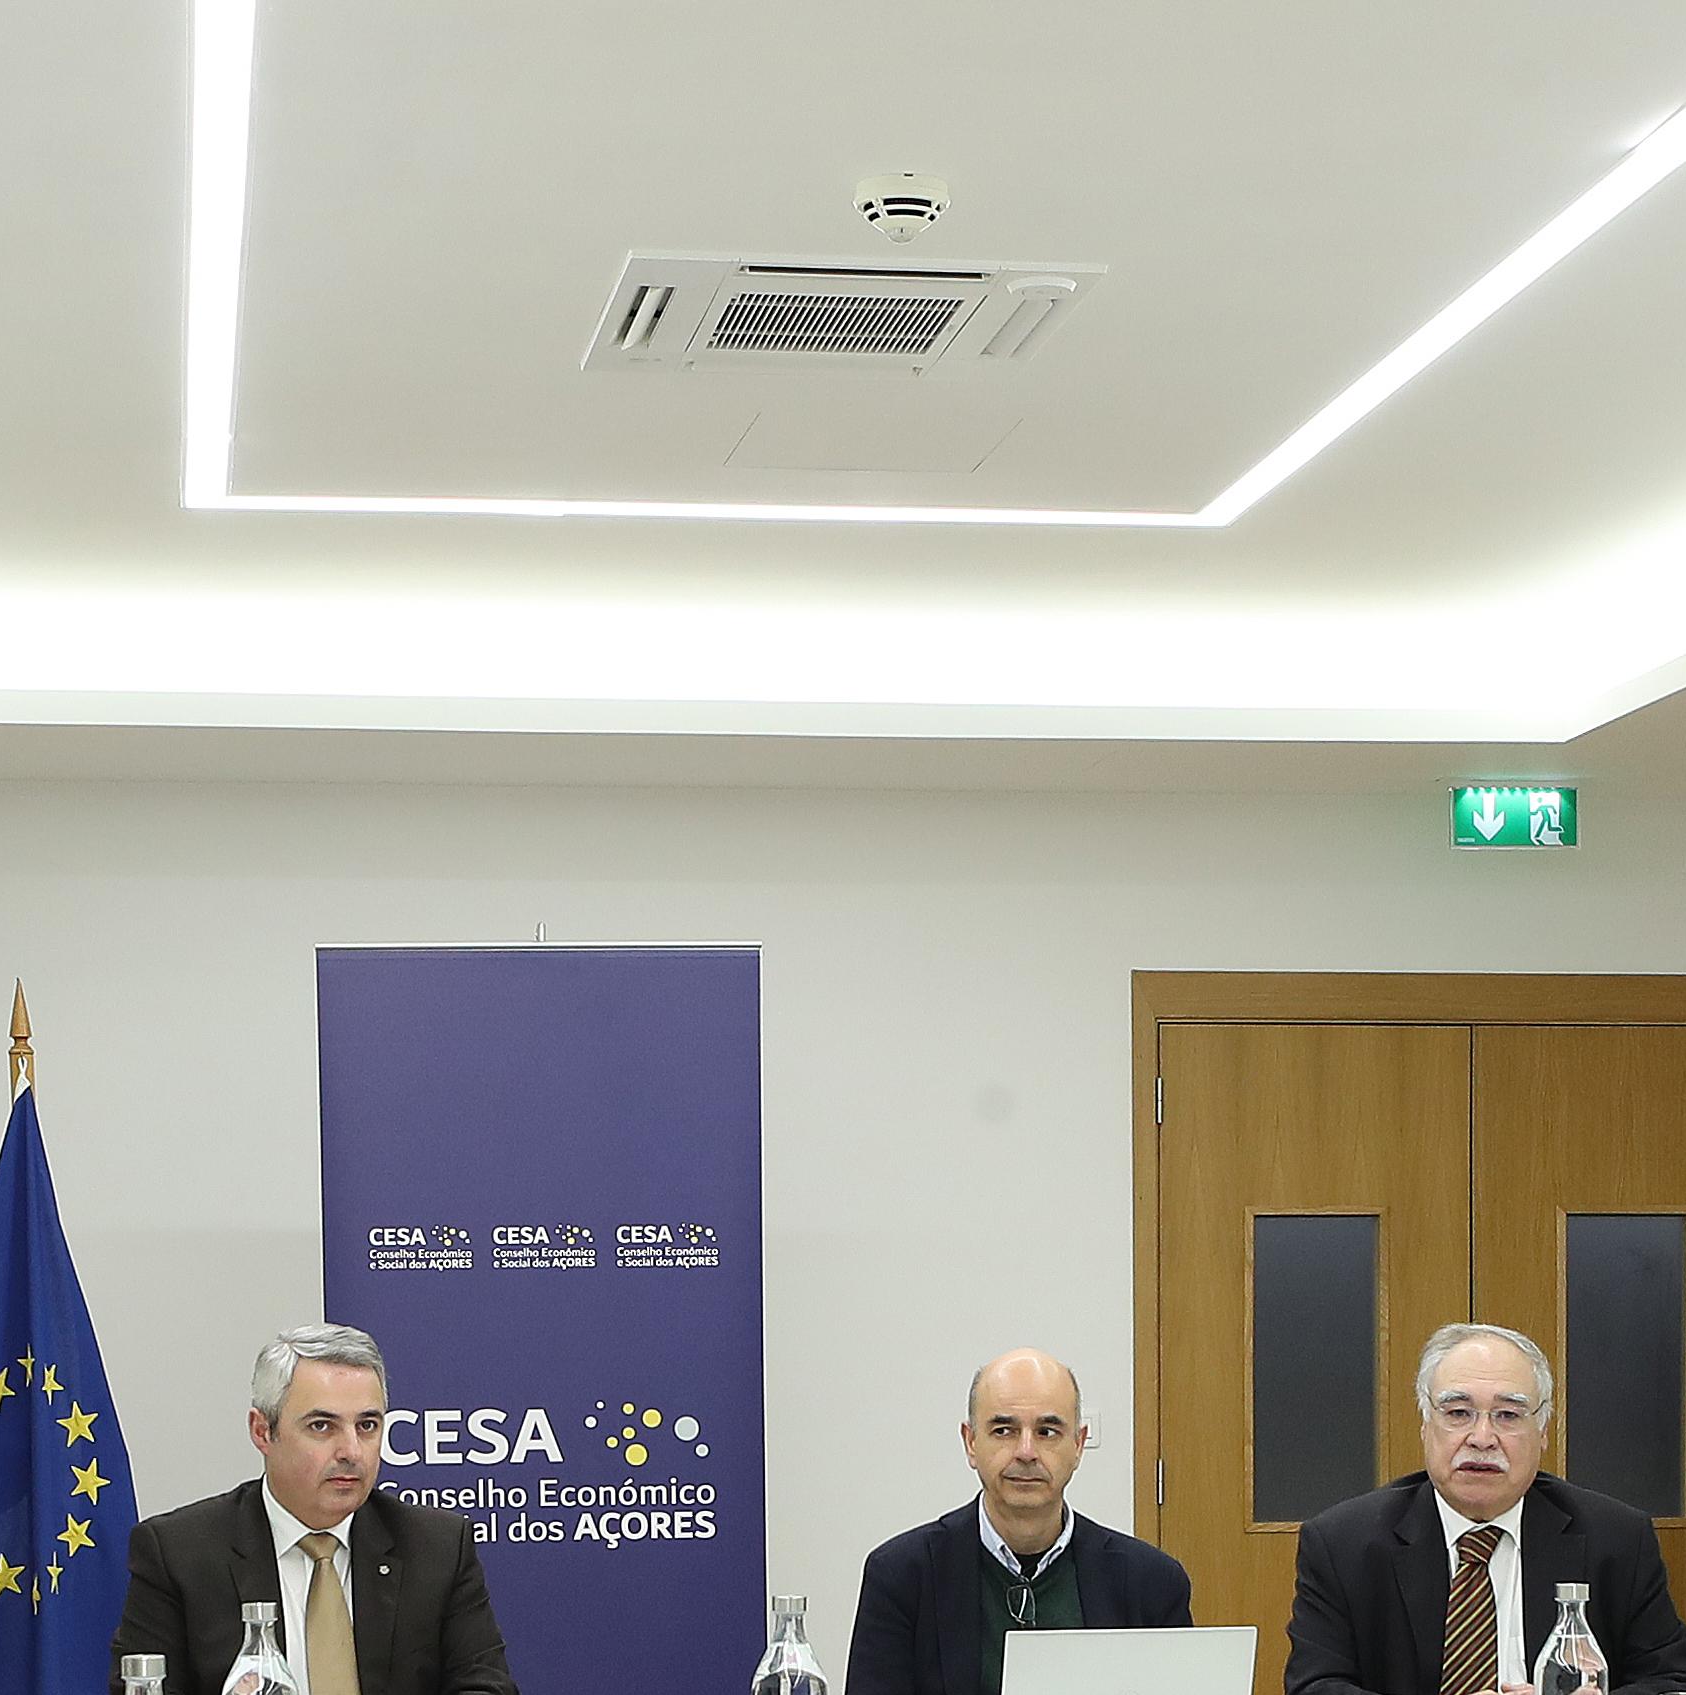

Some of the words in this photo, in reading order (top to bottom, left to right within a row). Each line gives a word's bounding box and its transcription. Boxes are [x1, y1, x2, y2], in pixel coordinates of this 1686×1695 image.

[369, 1227, 427, 1246] CESA
[492, 1226, 550, 1245] CESA
[616, 1225, 674, 1244] CESA
[369, 1249, 415, 1259] Conselho
[418, 1248, 473, 1259] Económico
[493, 1247, 539, 1258] Conselho
[542, 1247, 596, 1257] Económico
[616, 1246, 663, 1257] Conselho
[665, 1246, 719, 1256] Económico
[369, 1262, 376, 1270] e
[378, 1259, 407, 1270] Social
[409, 1259, 427, 1269] dos
[428, 1259, 473, 1272] AÇORES
[493, 1260, 500, 1269] e
[501, 1258, 531, 1269] Social
[532, 1258, 550, 1268] dos
[552, 1257, 596, 1270] AÇORES
[617, 1259, 624, 1268] e
[625, 1257, 654, 1268] Social
[655, 1257, 674, 1267] dos
[675, 1256, 719, 1269] AÇORES
[379, 1408, 563, 1466] CESA
[539, 1478, 716, 1508] Económico
[508, 1512, 564, 1542] dos
[573, 1510, 716, 1549] AÇORES
